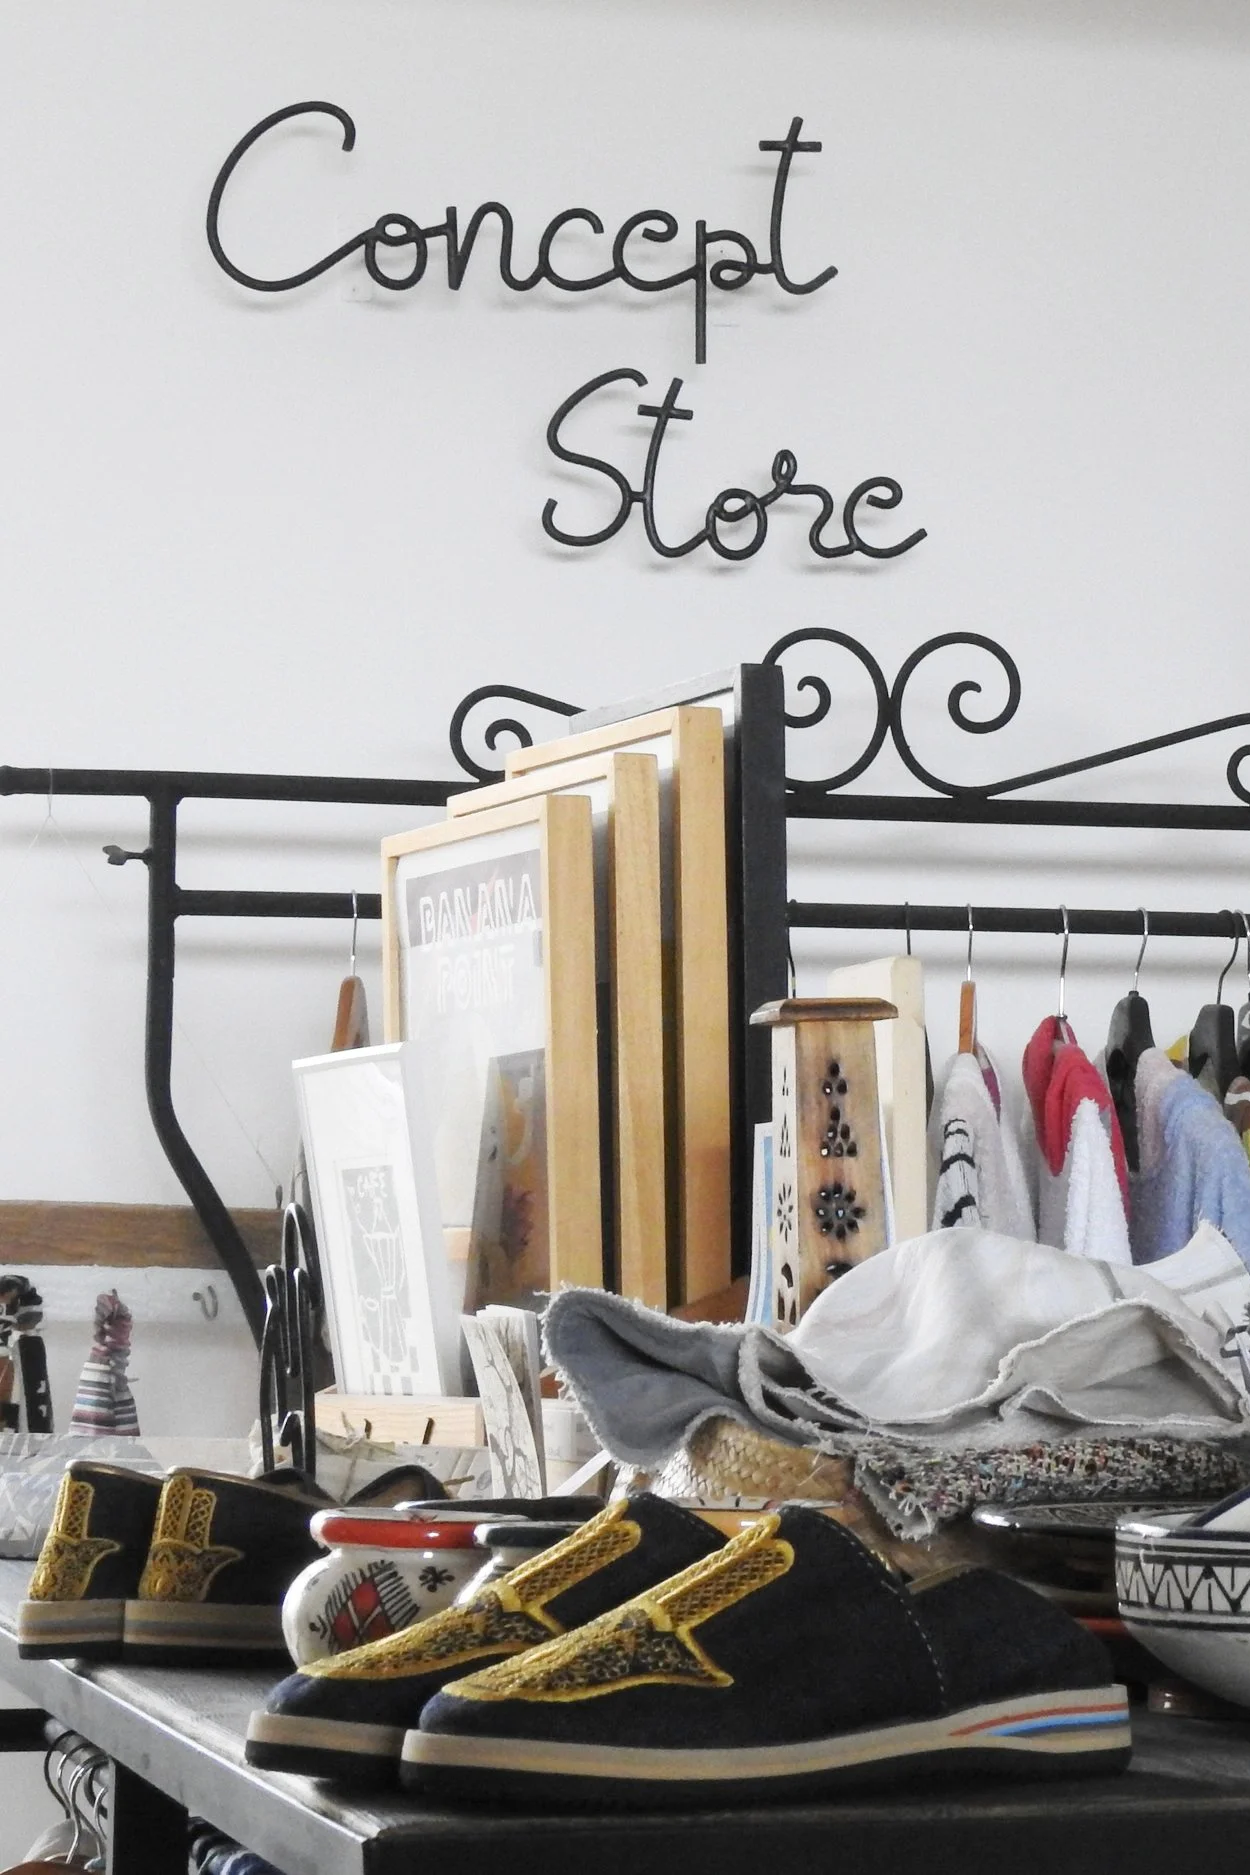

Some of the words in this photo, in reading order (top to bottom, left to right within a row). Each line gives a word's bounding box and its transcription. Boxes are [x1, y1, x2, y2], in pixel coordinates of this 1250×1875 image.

[206, 100, 839, 365] Concept
[541, 367, 928, 561] Store
[419, 873, 538, 952] BANANA
[436, 943, 515, 1014] POINT
